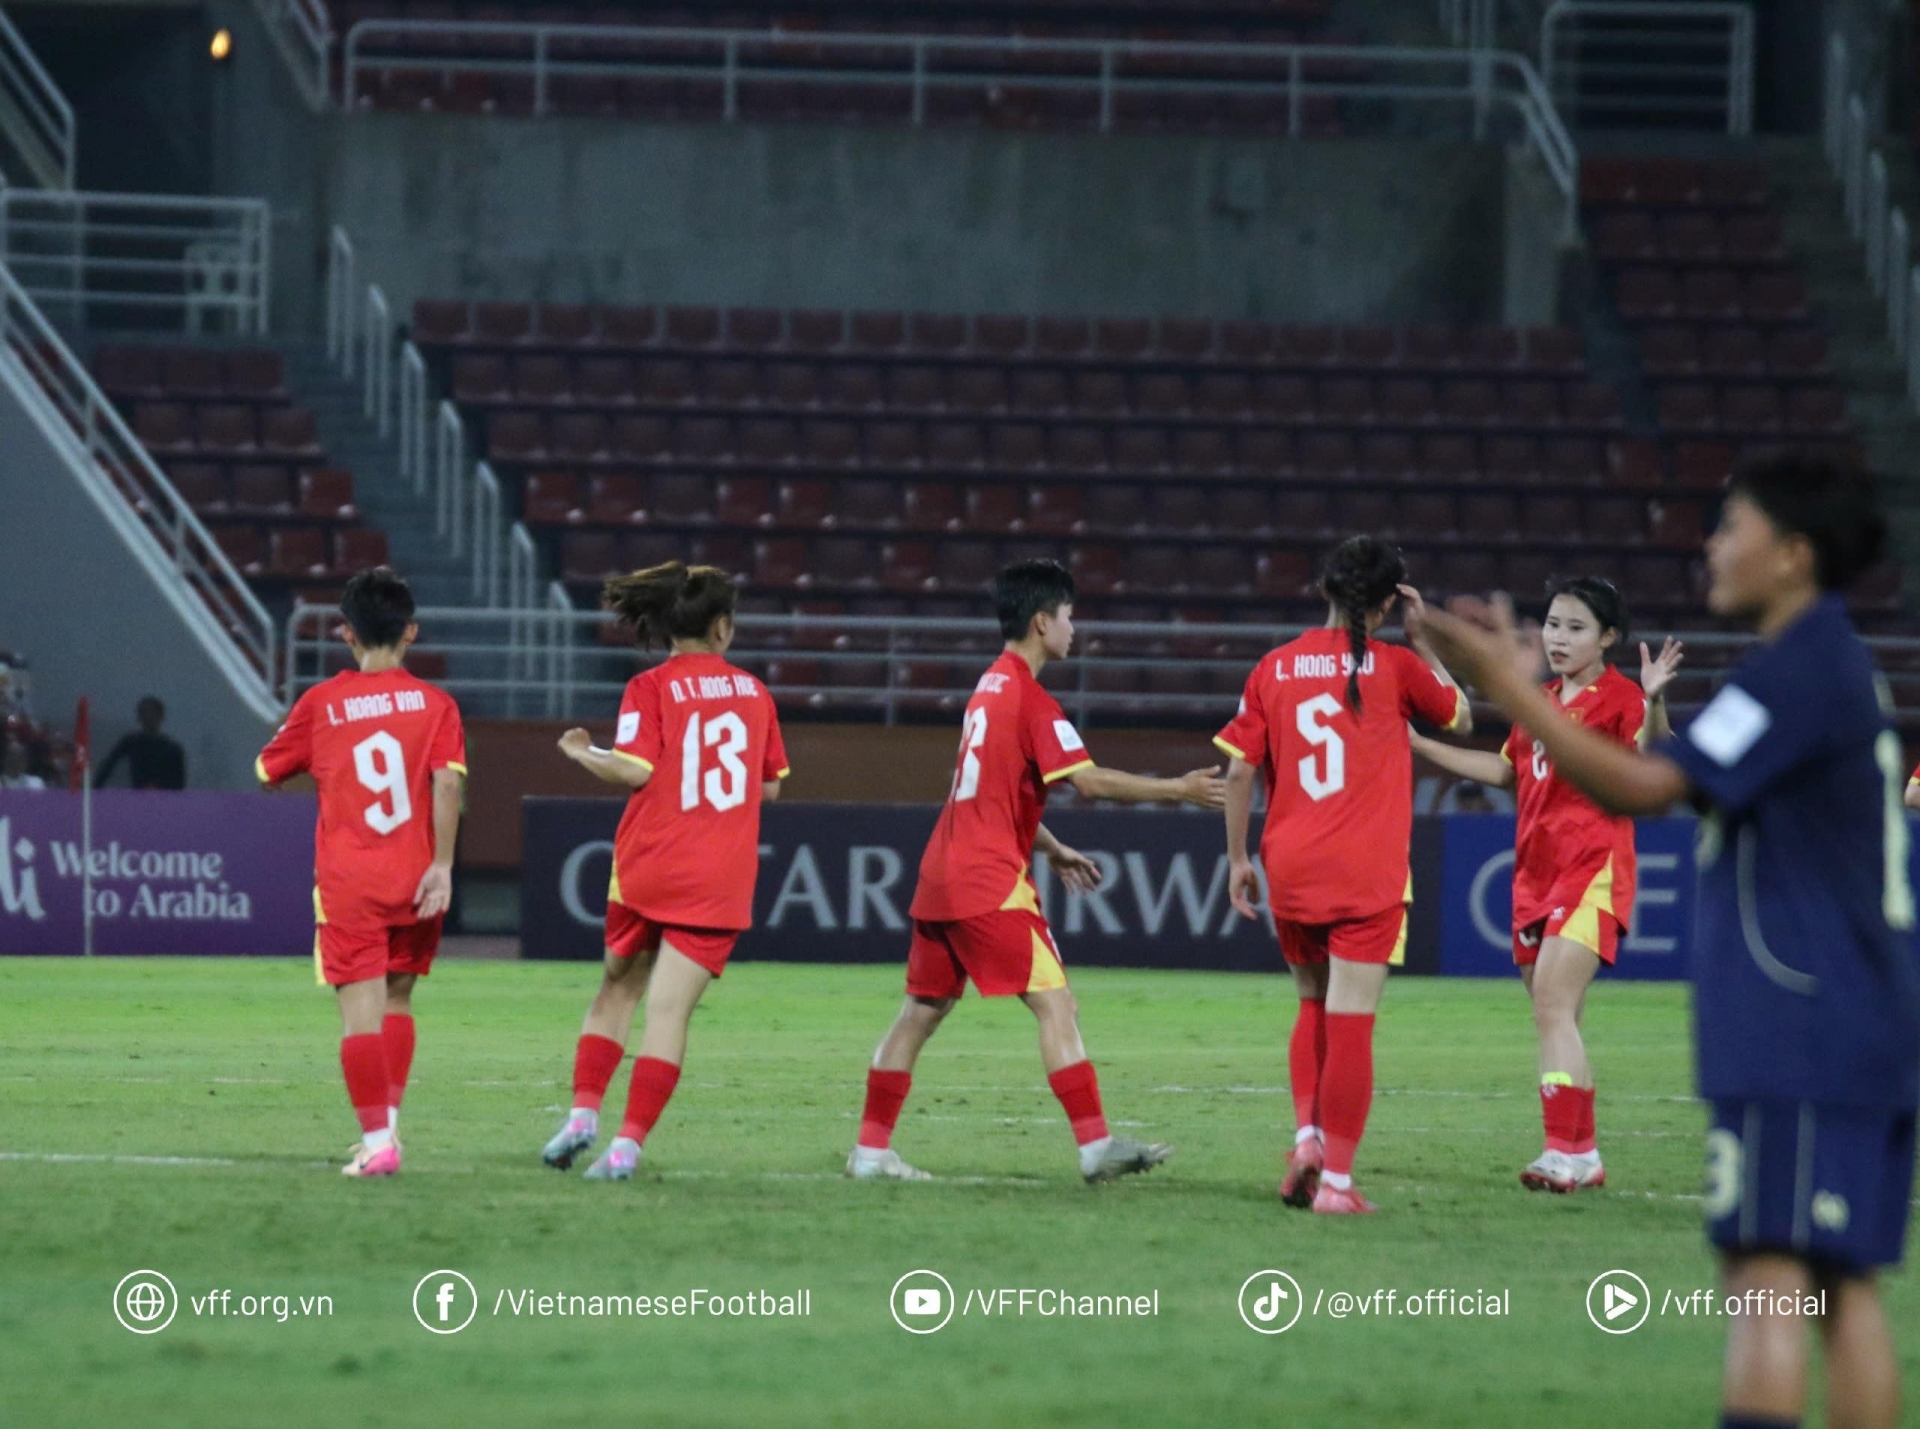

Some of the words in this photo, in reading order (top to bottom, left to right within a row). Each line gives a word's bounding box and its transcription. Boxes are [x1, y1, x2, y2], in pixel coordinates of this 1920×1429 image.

[1294, 654, 1337, 679] HONG
[1341, 651, 1374, 676] YU
[680, 710, 748, 812] 13
[1295, 691, 1345, 802] 5
[352, 729, 413, 836] 9
[50, 840, 223, 879] Welcome
[129, 881, 252, 919] Arabia
